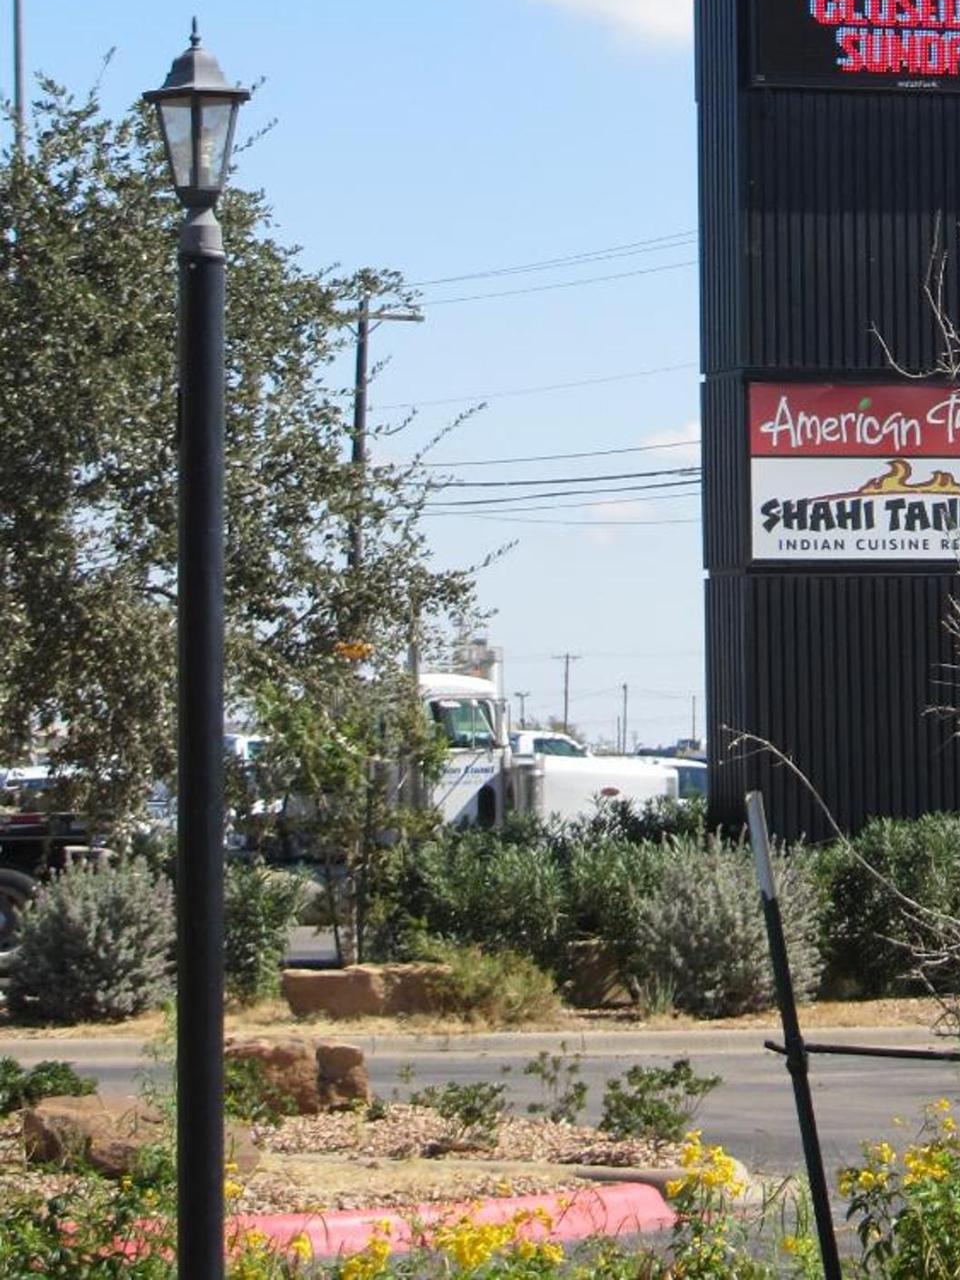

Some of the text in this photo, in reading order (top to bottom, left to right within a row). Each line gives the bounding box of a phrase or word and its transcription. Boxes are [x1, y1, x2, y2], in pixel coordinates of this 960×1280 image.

[760, 396, 921, 451] American
[760, 498, 875, 533] SHAHI
[779, 538, 845, 551] INDIAN
[856, 538, 930, 551] CUISINE
